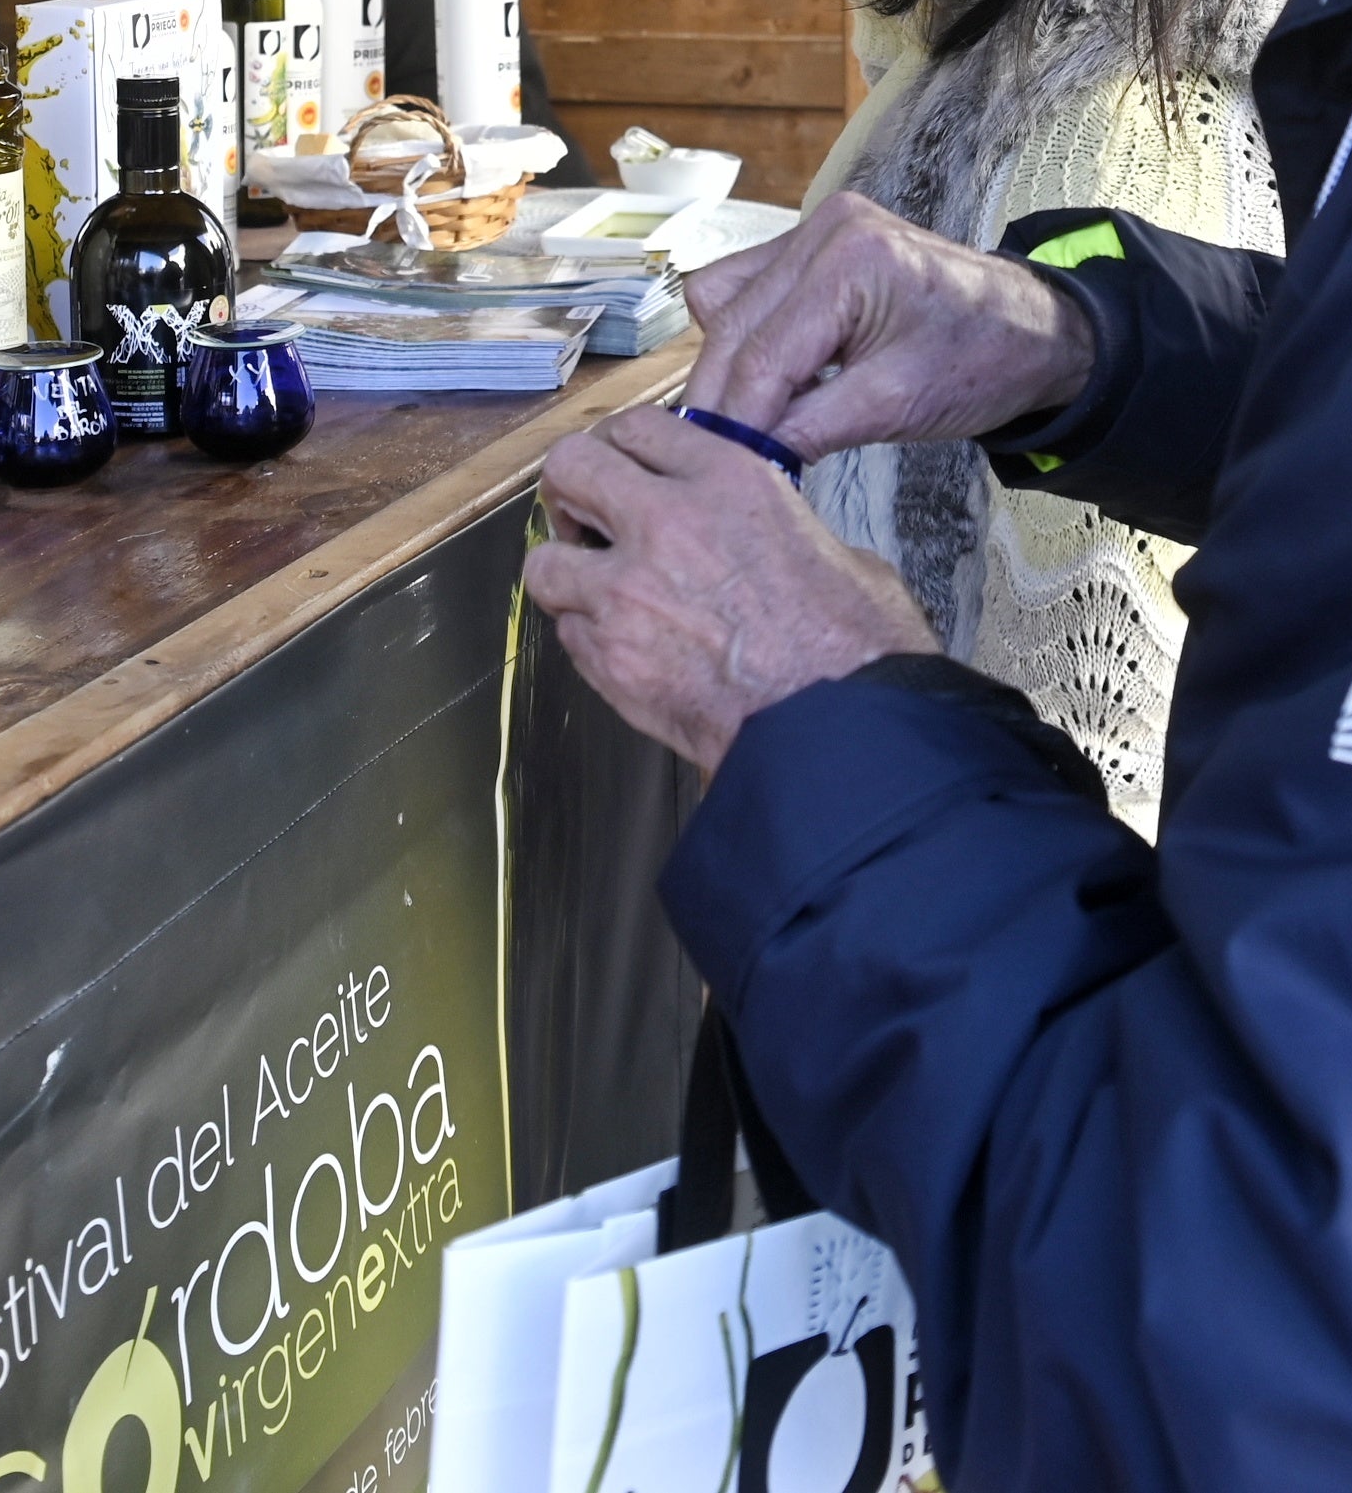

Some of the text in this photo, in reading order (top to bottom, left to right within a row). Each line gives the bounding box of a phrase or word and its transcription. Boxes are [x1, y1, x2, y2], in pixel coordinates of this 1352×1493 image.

[151, 19, 177, 32] PRIEGO
[33, 373, 98, 402] VENTA
[147, 1083, 235, 1230] del
[250, 964, 392, 1146] Aceite
[184, 1157, 463, 1483] virgenextra
